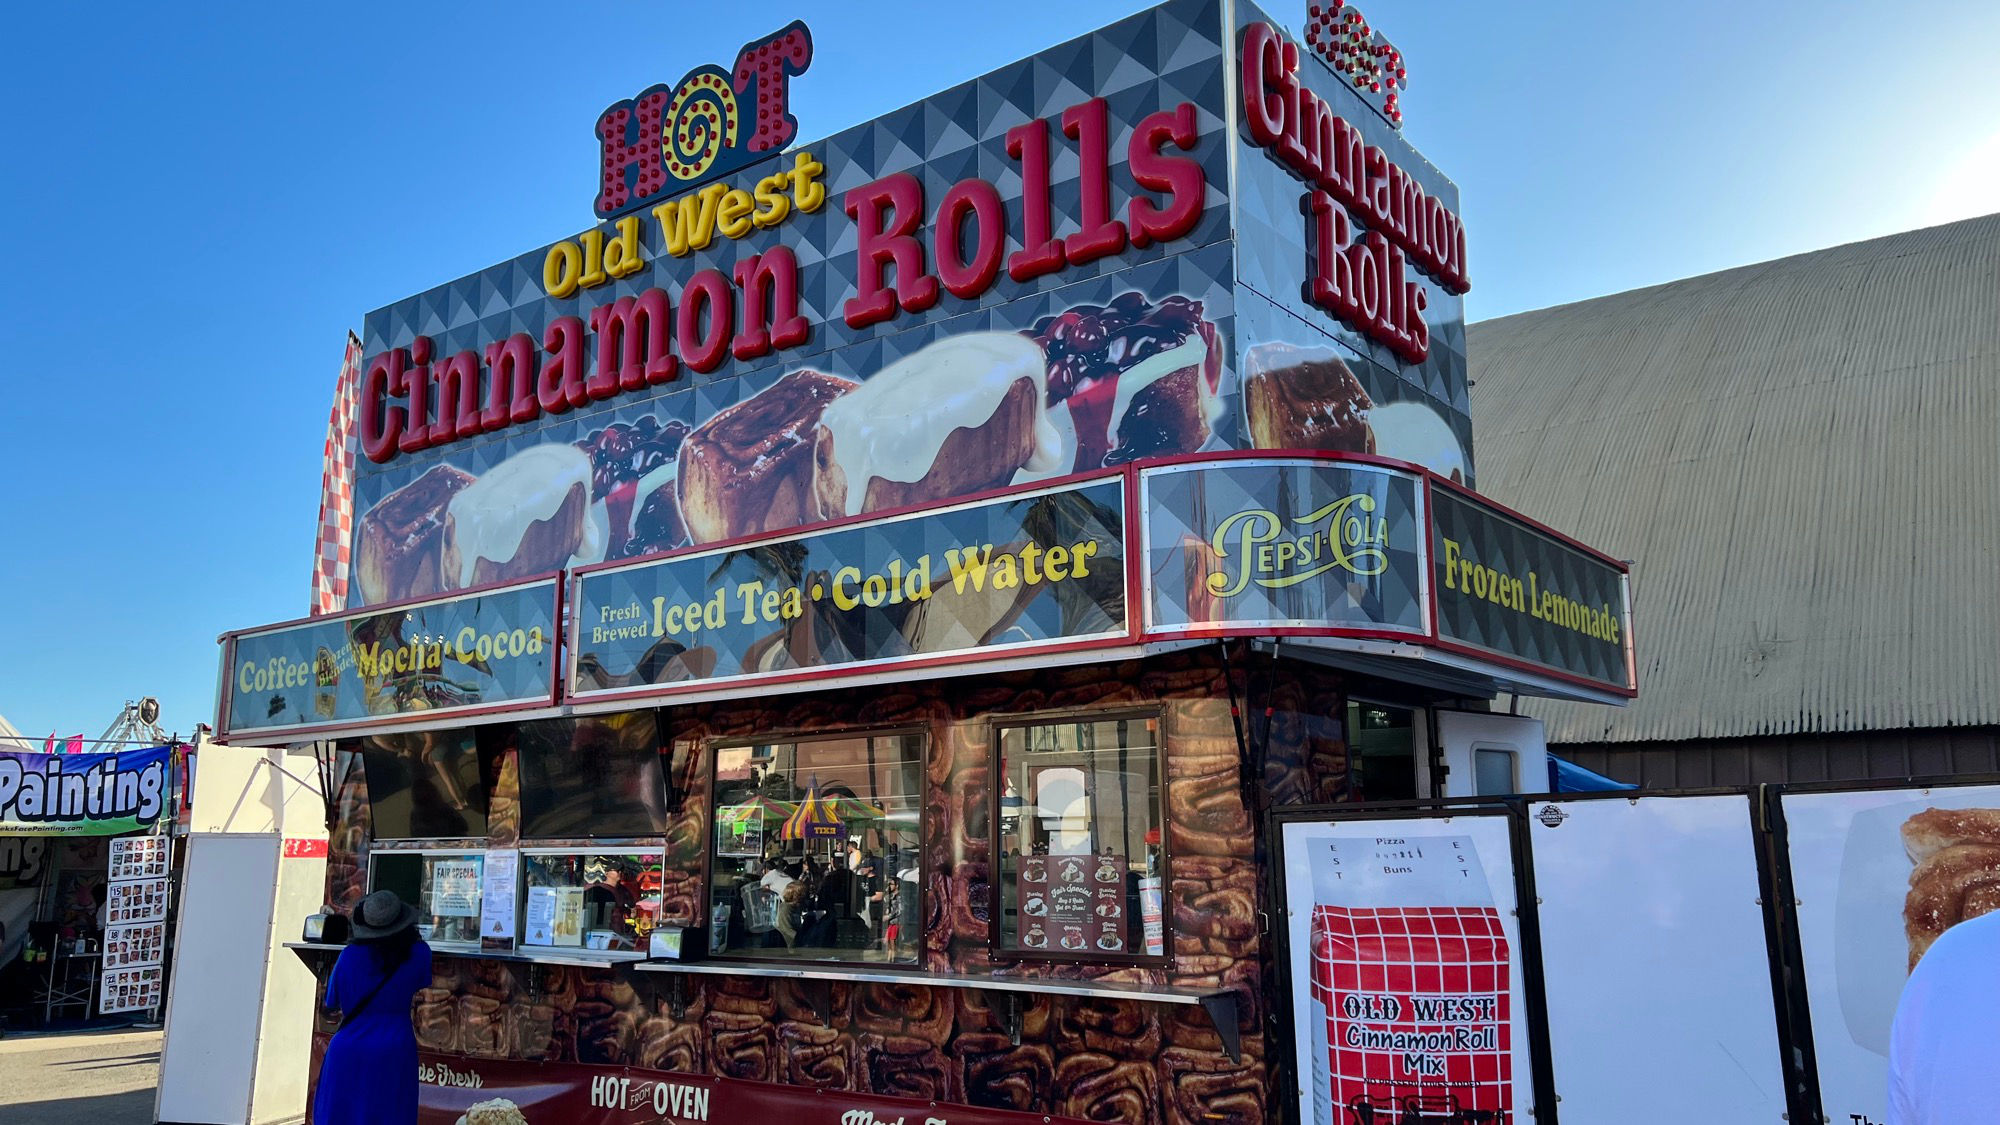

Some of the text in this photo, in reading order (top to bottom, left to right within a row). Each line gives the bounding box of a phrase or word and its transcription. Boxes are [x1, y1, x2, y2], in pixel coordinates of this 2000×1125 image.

[598, 28, 809, 212] HOT
[1242, 21, 1471, 294] Cinnamon
[543, 152, 825, 299] Old West
[359, 97, 1204, 463] Cinnamon Rolls
[1312, 189, 1429, 364] Rolls
[651, 538, 1098, 637] Iced Tea Cold Water
[1443, 537, 1619, 645] Frozen Lemonade
[592, 620, 647, 644] Brewed
[600, 602, 640, 624] Fresh
[357, 626, 542, 679] Mocha Cocoa
[240, 656, 308, 694] Coffee
[0, 757, 163, 820] Painting
[1375, 837, 1405, 846] Pizza
[1066, 884, 1093, 898] Special
[1383, 865, 1413, 875] Buns
[1343, 996, 1495, 1021] OLD WEST
[1346, 1025, 1495, 1050] Cinnamon Roll
[436, 1062, 483, 1089] Fresh
[1404, 1053, 1444, 1075] Mix
[591, 1075, 710, 1122] HOT FROM OVEN
